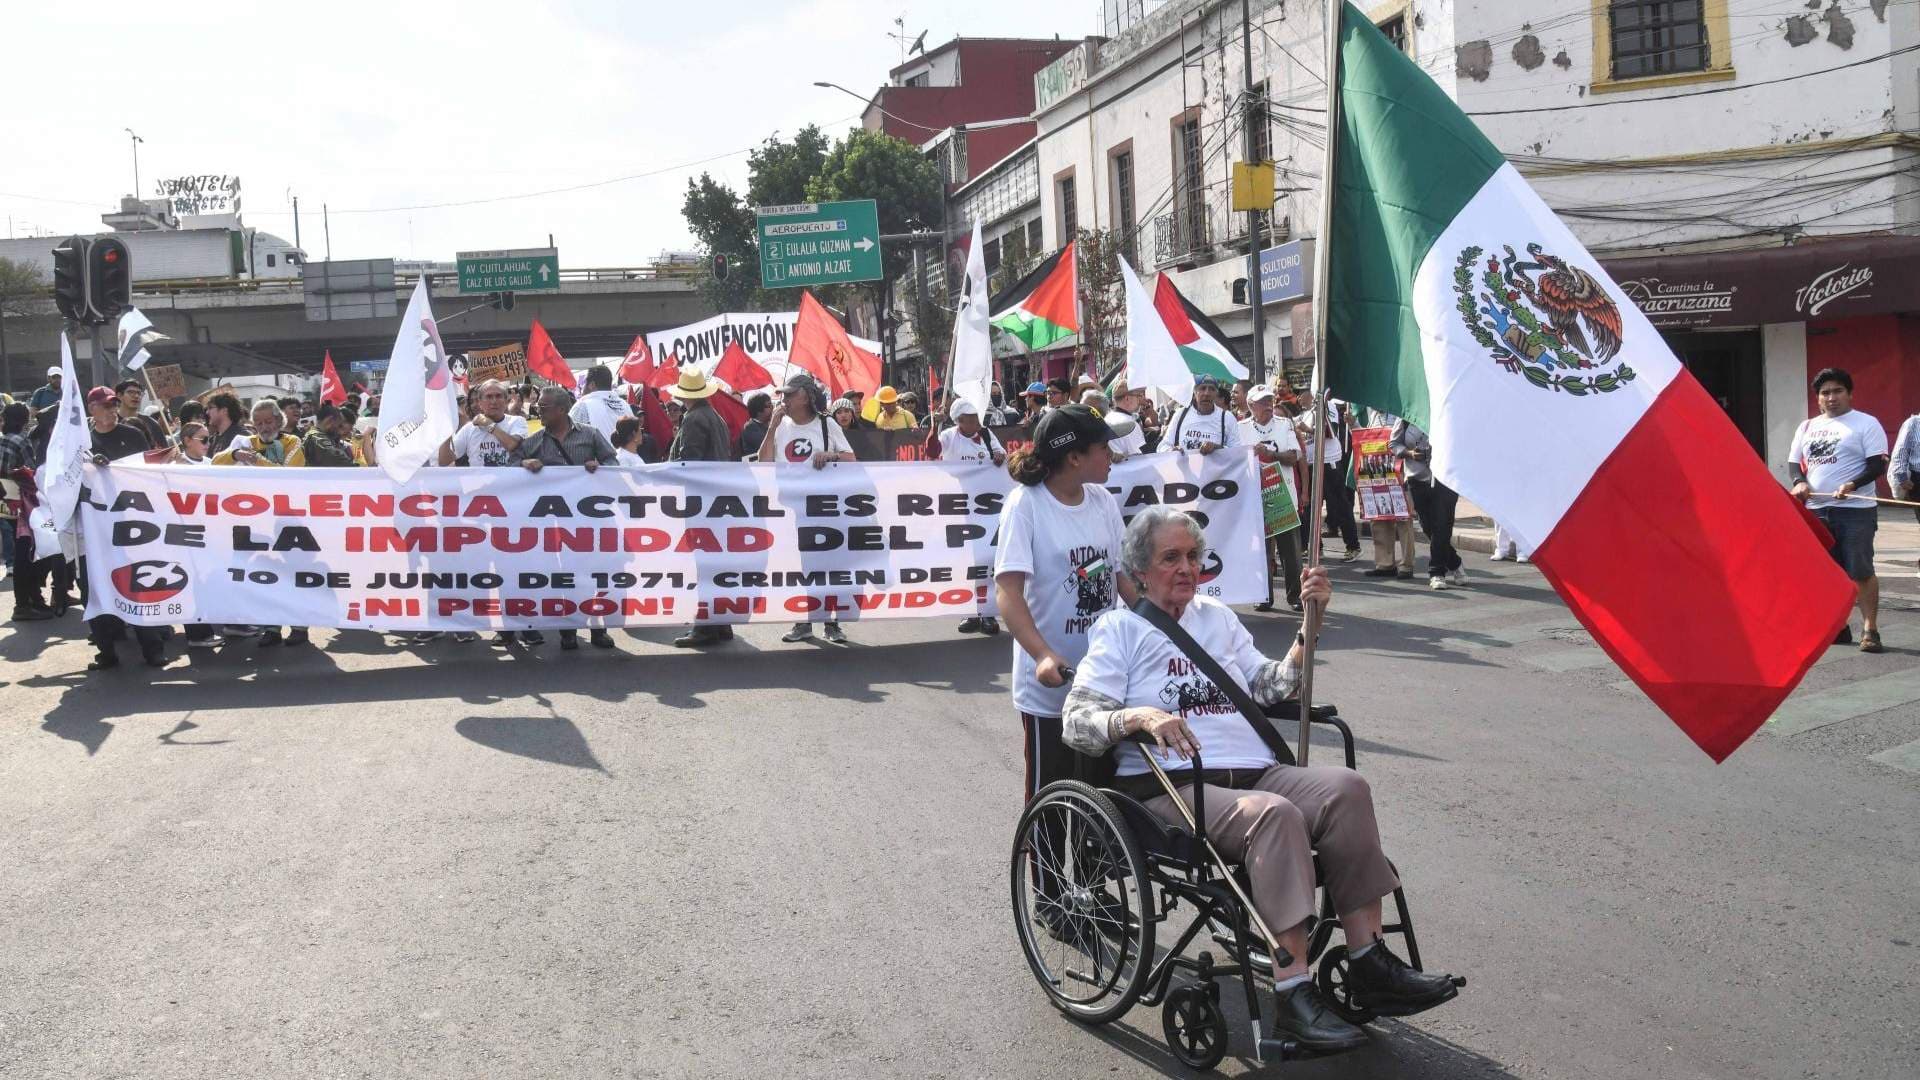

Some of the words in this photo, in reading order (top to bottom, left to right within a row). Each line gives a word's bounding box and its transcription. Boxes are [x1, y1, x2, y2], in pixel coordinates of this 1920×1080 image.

[771, 223, 831, 234] AEROPUERTO
[786, 242, 817, 257] EULALIA
[820, 239, 851, 254] GUZMAN
[466, 264, 476, 274] AV
[480, 262, 532, 274] CUITLAHUAC
[788, 261, 821, 278] ANTONIO
[824, 259, 852, 274] ALZATE
[466, 278, 482, 288] CALZ
[484, 277, 493, 287] DE
[495, 276, 507, 287] LOS
[509, 275, 532, 286] GALLOS
[1657, 282, 1700, 293] Cantina
[1704, 281, 1714, 291] la
[1795, 262, 1873, 316] Victoria
[673, 316, 787, 368] CONVENCIÓN
[1185, 430, 1202, 438] ALTO
[480, 441, 496, 449] ALTO
[167, 491, 507, 518] VIOLENCIA
[528, 495, 785, 518] ACTUAL
[806, 494, 877, 517] ES
[112, 519, 206, 548] DE
[232, 525, 321, 551] LA
[345, 526, 774, 552] IMPUNIDAD
[798, 525, 924, 552] DEL
[1070, 545, 1096, 567] ALTO
[228, 568, 279, 584] 10
[295, 571, 351, 588] DE
[366, 572, 504, 589] JUNIO
[518, 572, 576, 589] DE
[592, 572, 698, 590] 1971,
[713, 569, 885, 587] CRIMEN
[900, 567, 953, 584] DE
[1207, 586, 1221, 597] 68
[167, 603, 182, 615] 68
[347, 598, 421, 621] ¡NI
[438, 591, 675, 616] PERDÓN!
[695, 596, 766, 620] ¡NI
[783, 585, 988, 613] OLVIDO!
